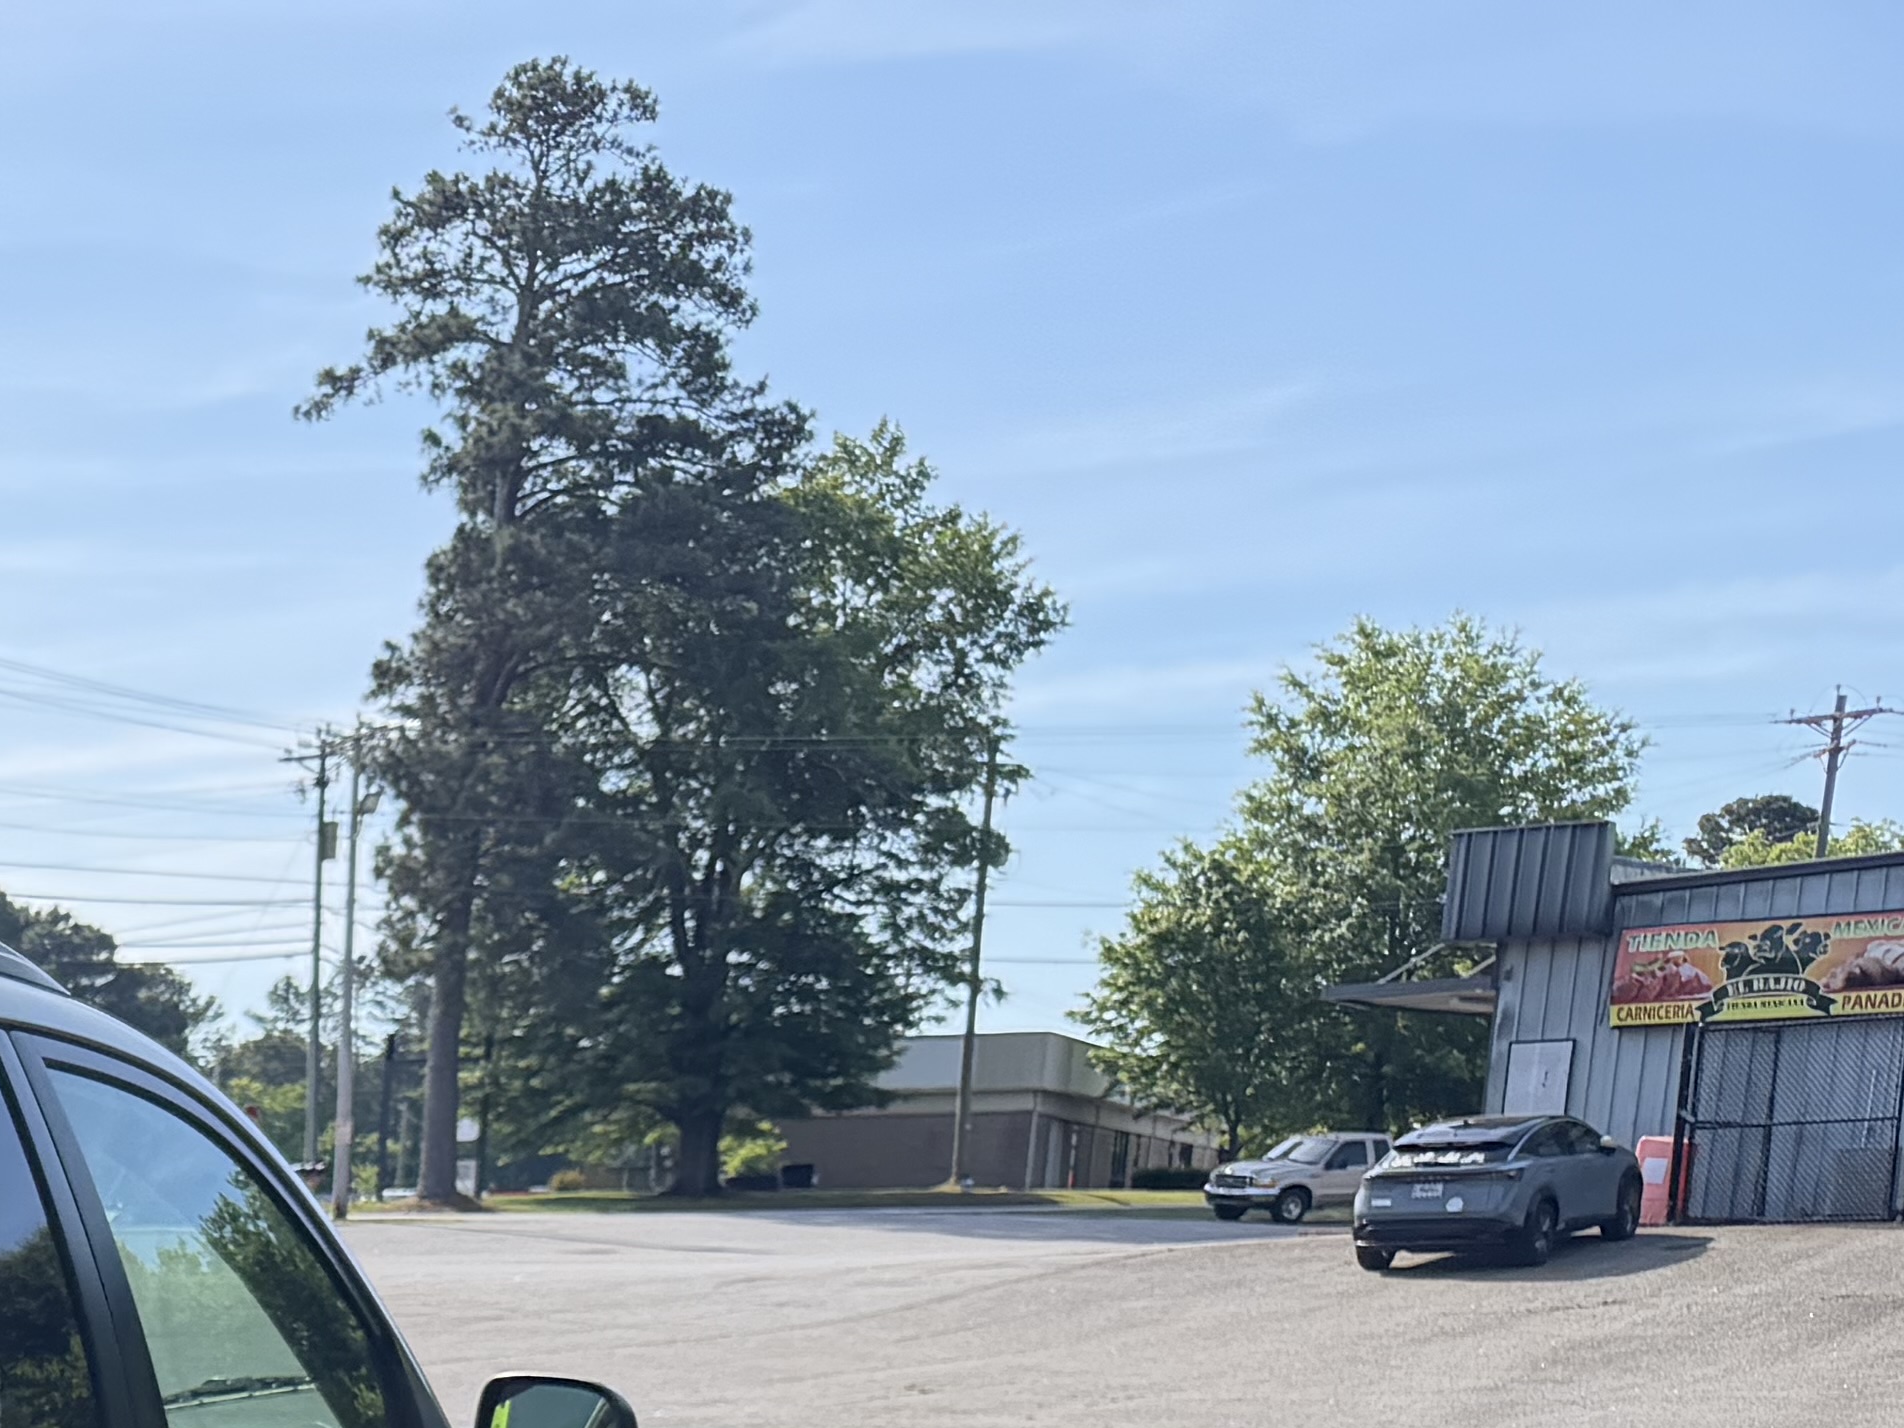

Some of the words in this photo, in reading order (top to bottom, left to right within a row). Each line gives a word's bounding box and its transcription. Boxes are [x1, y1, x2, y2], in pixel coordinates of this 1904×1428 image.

[1626, 929, 1720, 953] TIENDA
[1832, 915, 1904, 938] MEXIC
[1841, 992, 1904, 1011] PANAD
[1616, 1003, 1695, 1022] CARNICERIA
